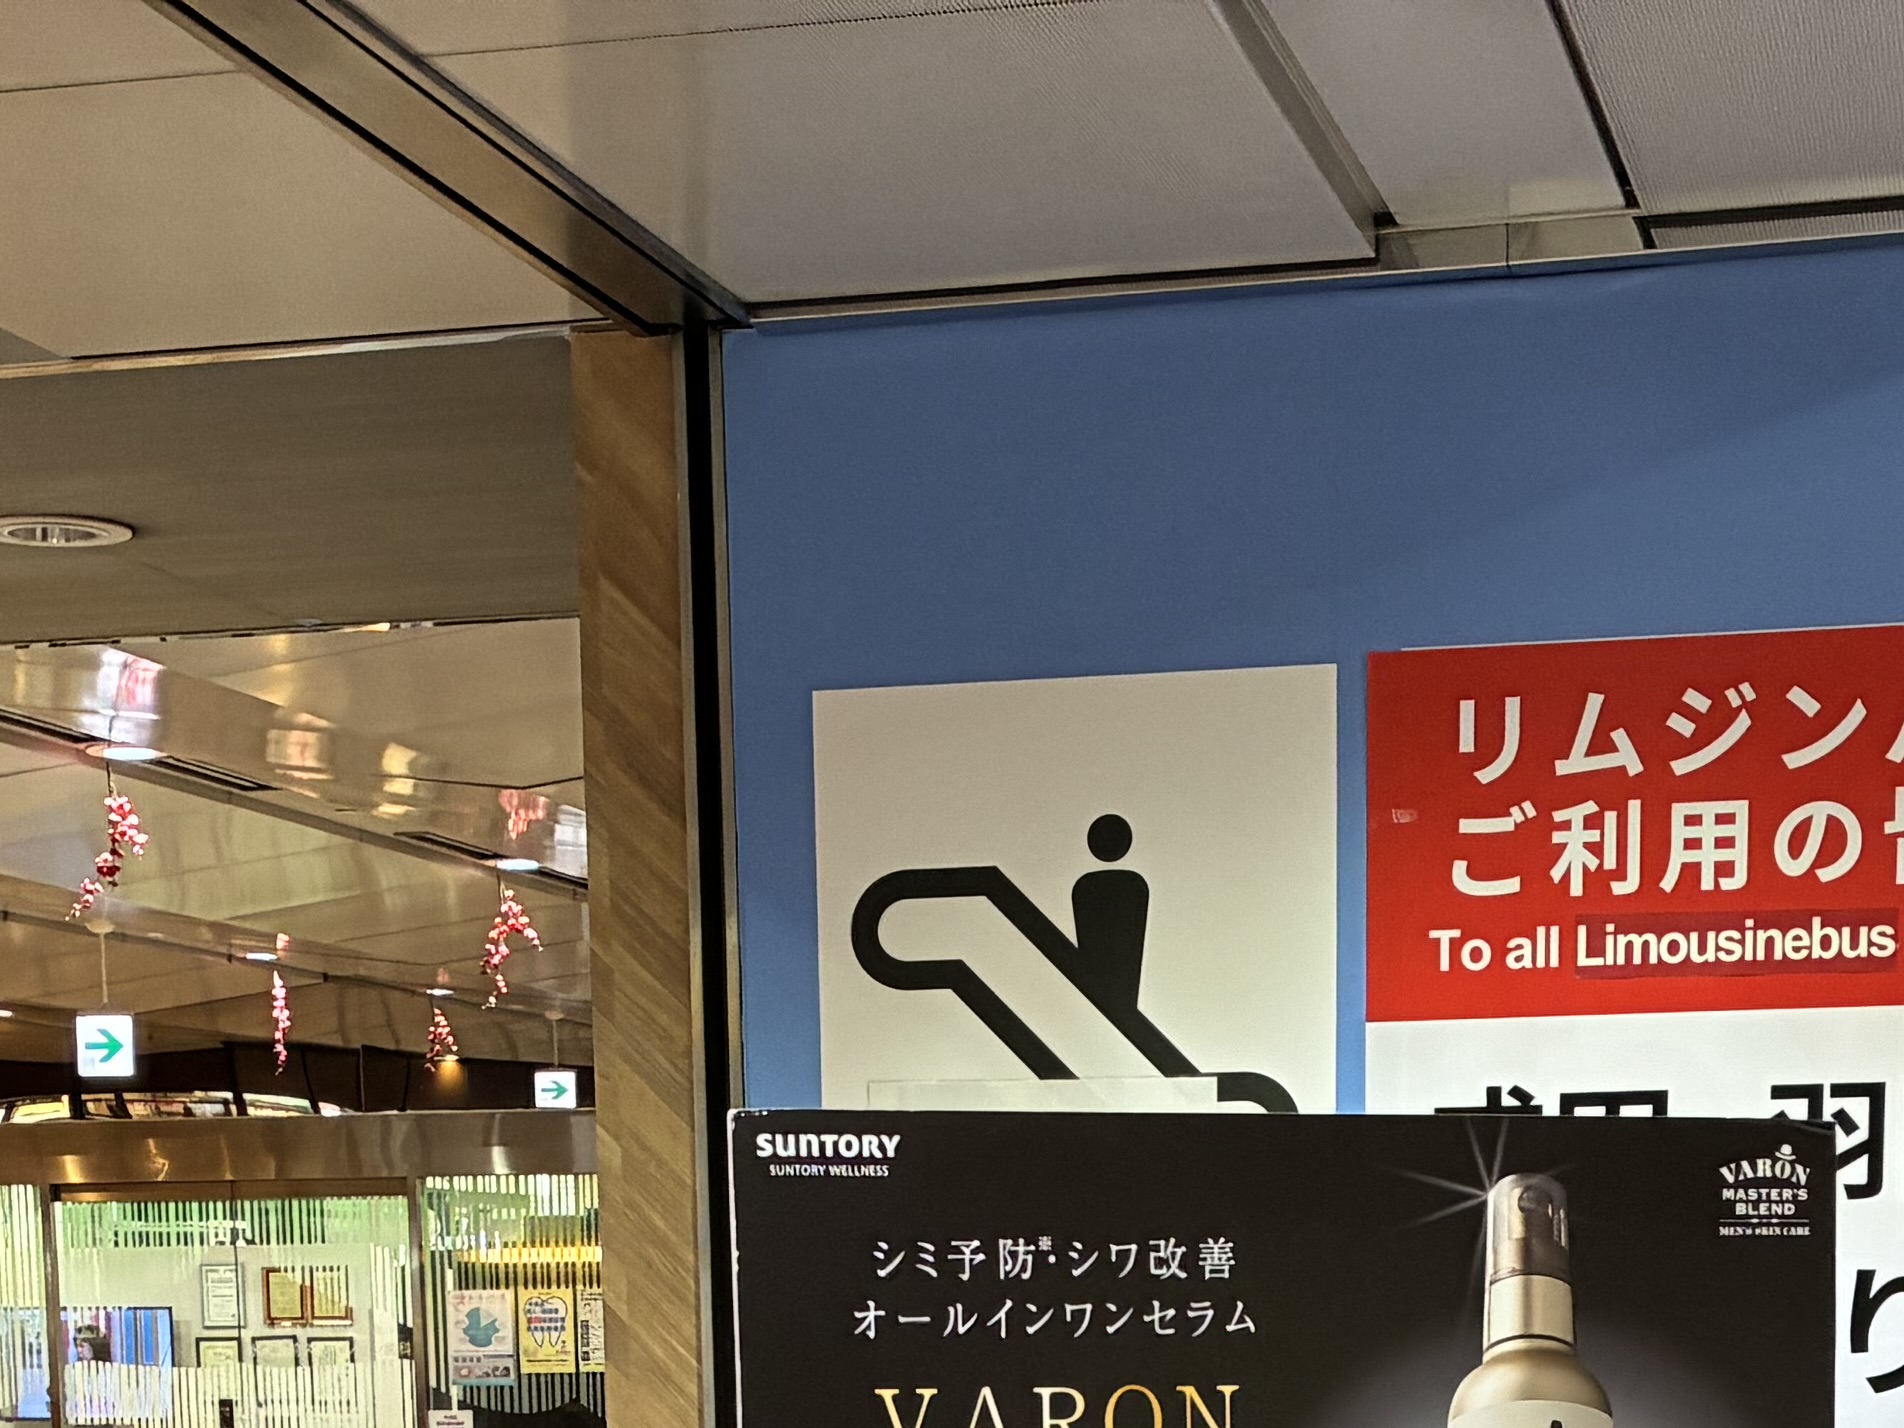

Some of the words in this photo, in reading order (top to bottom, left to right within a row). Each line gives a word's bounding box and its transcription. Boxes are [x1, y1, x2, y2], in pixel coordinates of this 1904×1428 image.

[1430, 928, 1492, 972] To
[1506, 925, 1559, 968] all
[1576, 918, 1897, 967] Limousinebus
[756, 1132, 900, 1160] SUNTORY
[768, 1164, 829, 1177] SUNTORY
[832, 1162, 889, 1177] WELLNESS
[1719, 1157, 1810, 1186] VARON
[1722, 1188, 1809, 1201] MASTER'S
[1735, 1203, 1796, 1216] BLEND
[853, 1297, 1258, 1340] オールインワンセラム
